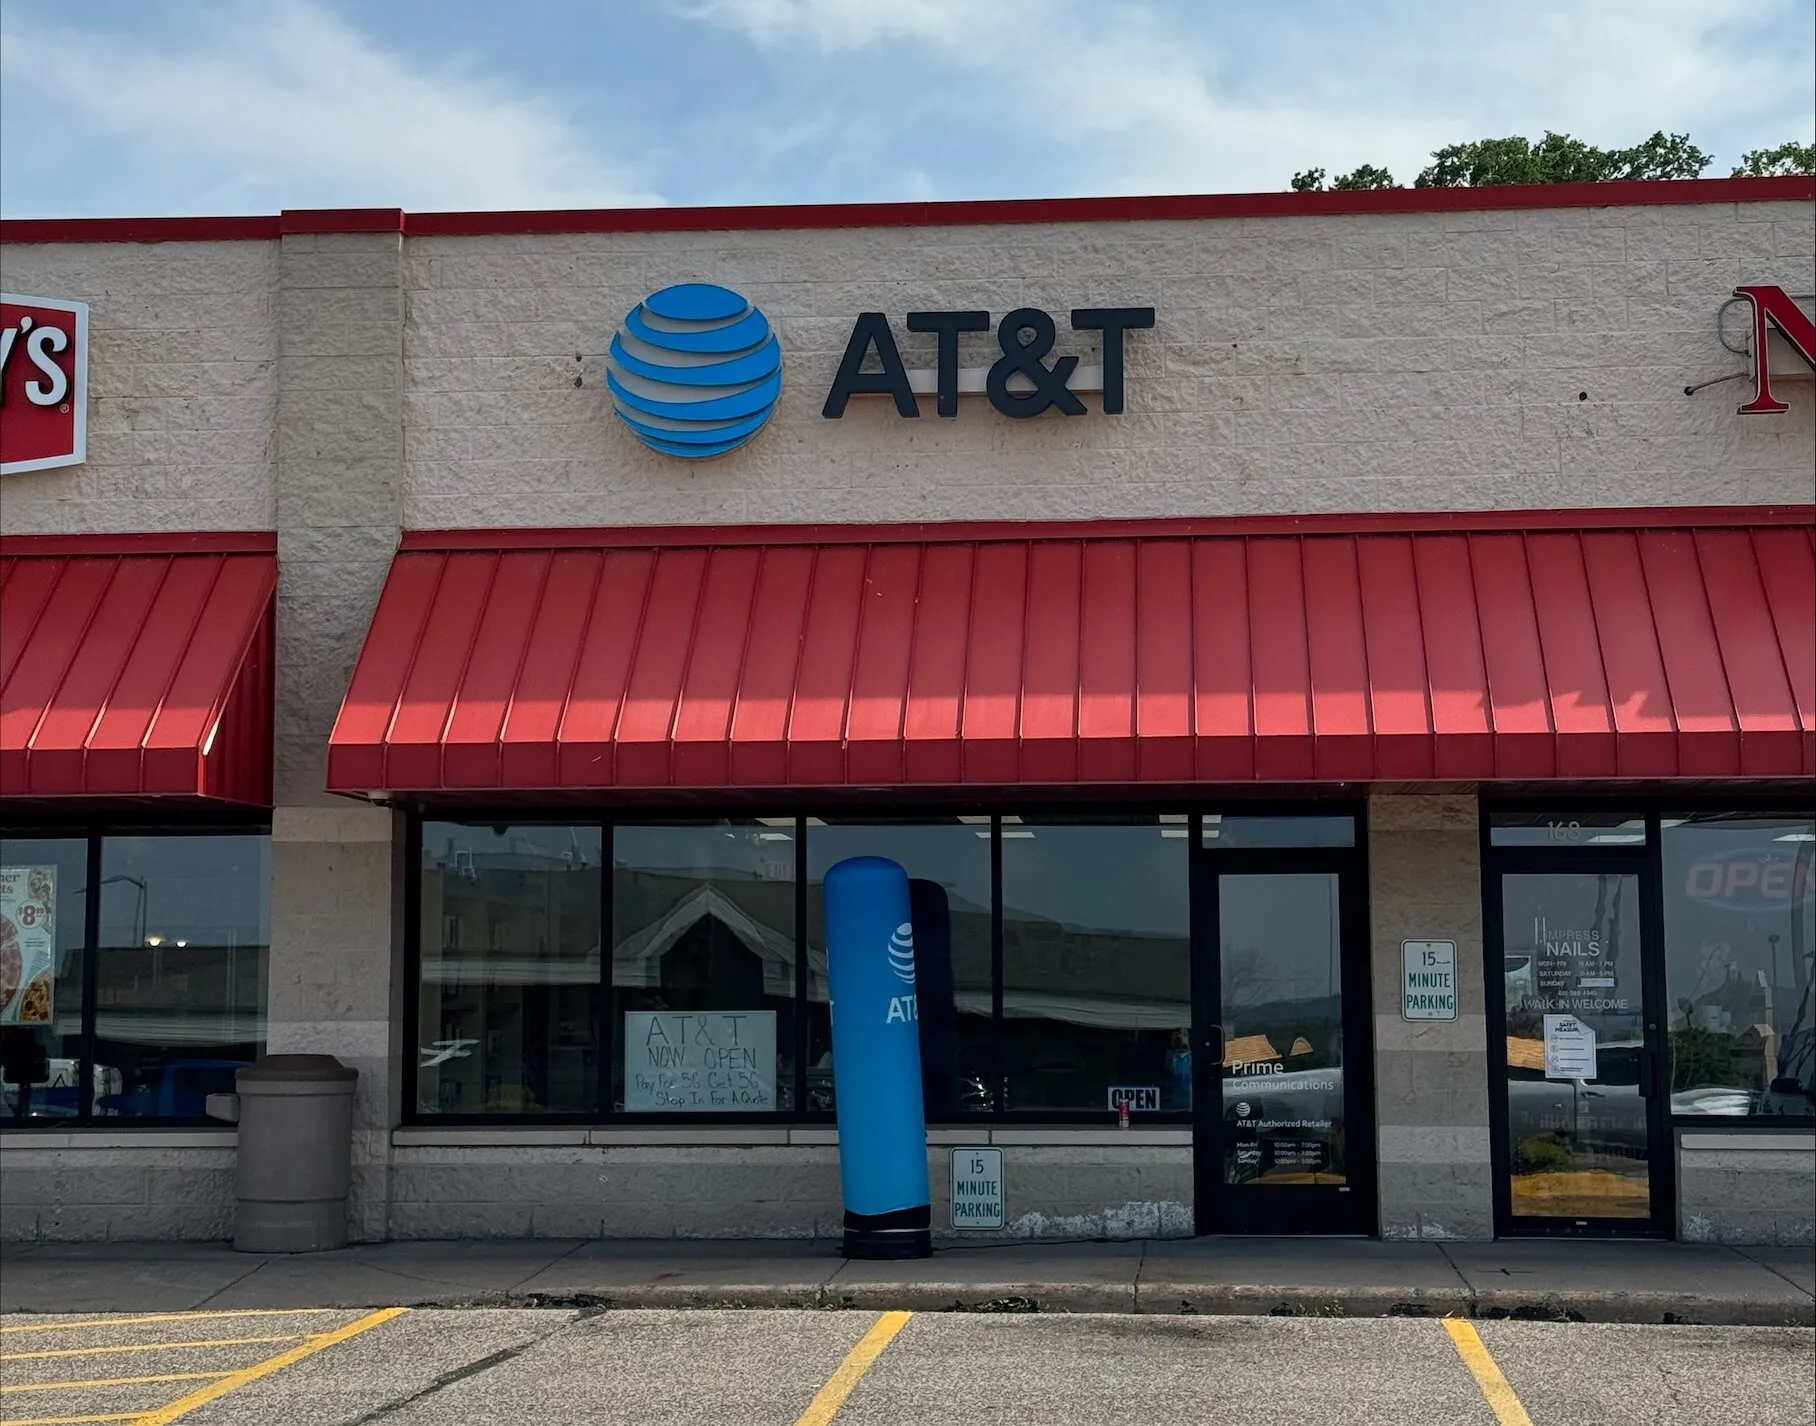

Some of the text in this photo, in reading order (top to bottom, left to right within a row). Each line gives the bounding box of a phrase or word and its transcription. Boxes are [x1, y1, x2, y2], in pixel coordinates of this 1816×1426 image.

[822, 307, 1155, 419] AT&T
[1547, 821, 1581, 841] 168
[1546, 942, 1601, 957] NAILS
[1421, 951, 1436, 967] 15
[1408, 972, 1451, 988] MINUTE
[1406, 994, 1454, 1010] PARKING
[1571, 998, 1629, 1010] WELCOME
[648, 1045, 757, 1070] NOW OPEN
[1231, 1060, 1284, 1075] Prime
[635, 1073, 655, 1096] Pay
[708, 1072, 732, 1089] Get
[1232, 1079, 1334, 1091] Communications
[655, 1090, 686, 1108] Stop
[710, 1090, 726, 1105] For
[1111, 1088, 1157, 1109] OPEN
[1236, 1119, 1332, 1128] AT&T Authorized Retailer
[969, 1158, 985, 1175] 15
[1236, 1158, 1258, 1166] Sunday
[956, 1180, 998, 1196] MINUTE
[954, 1202, 1001, 1219] PARKING
